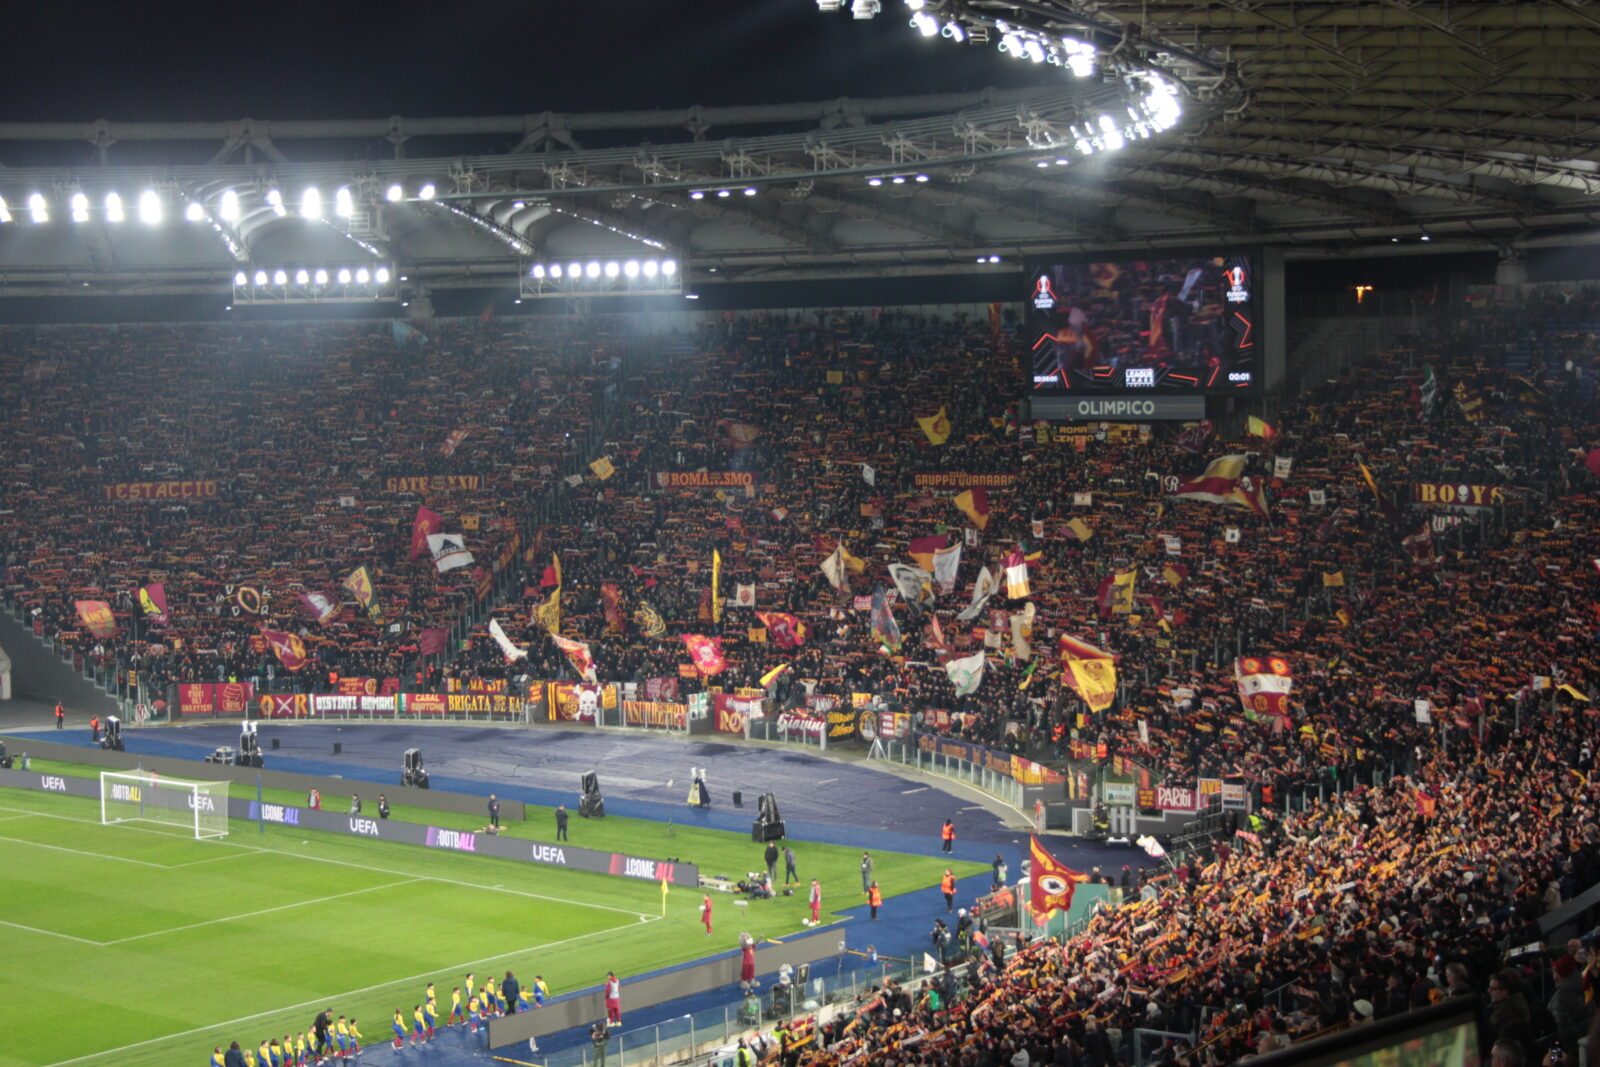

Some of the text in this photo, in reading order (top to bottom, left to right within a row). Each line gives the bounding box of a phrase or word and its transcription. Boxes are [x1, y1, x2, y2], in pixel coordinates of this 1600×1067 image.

[1228, 372, 1250, 382] 00:01
[1078, 400, 1156, 415] OLIMPICO
[1053, 433, 1094, 443] CENO
[670, 471, 752, 486] ROMASMO
[103, 480, 217, 499] TESTACCIO
[448, 695, 491, 711] BRIGATA
[41, 776, 66, 792] UEFA
[187, 794, 214, 811] UEFA
[284, 807, 299, 824] ALL
[349, 818, 379, 836] UEFA
[532, 845, 566, 864] UEFA
[655, 862, 675, 882] ALL
